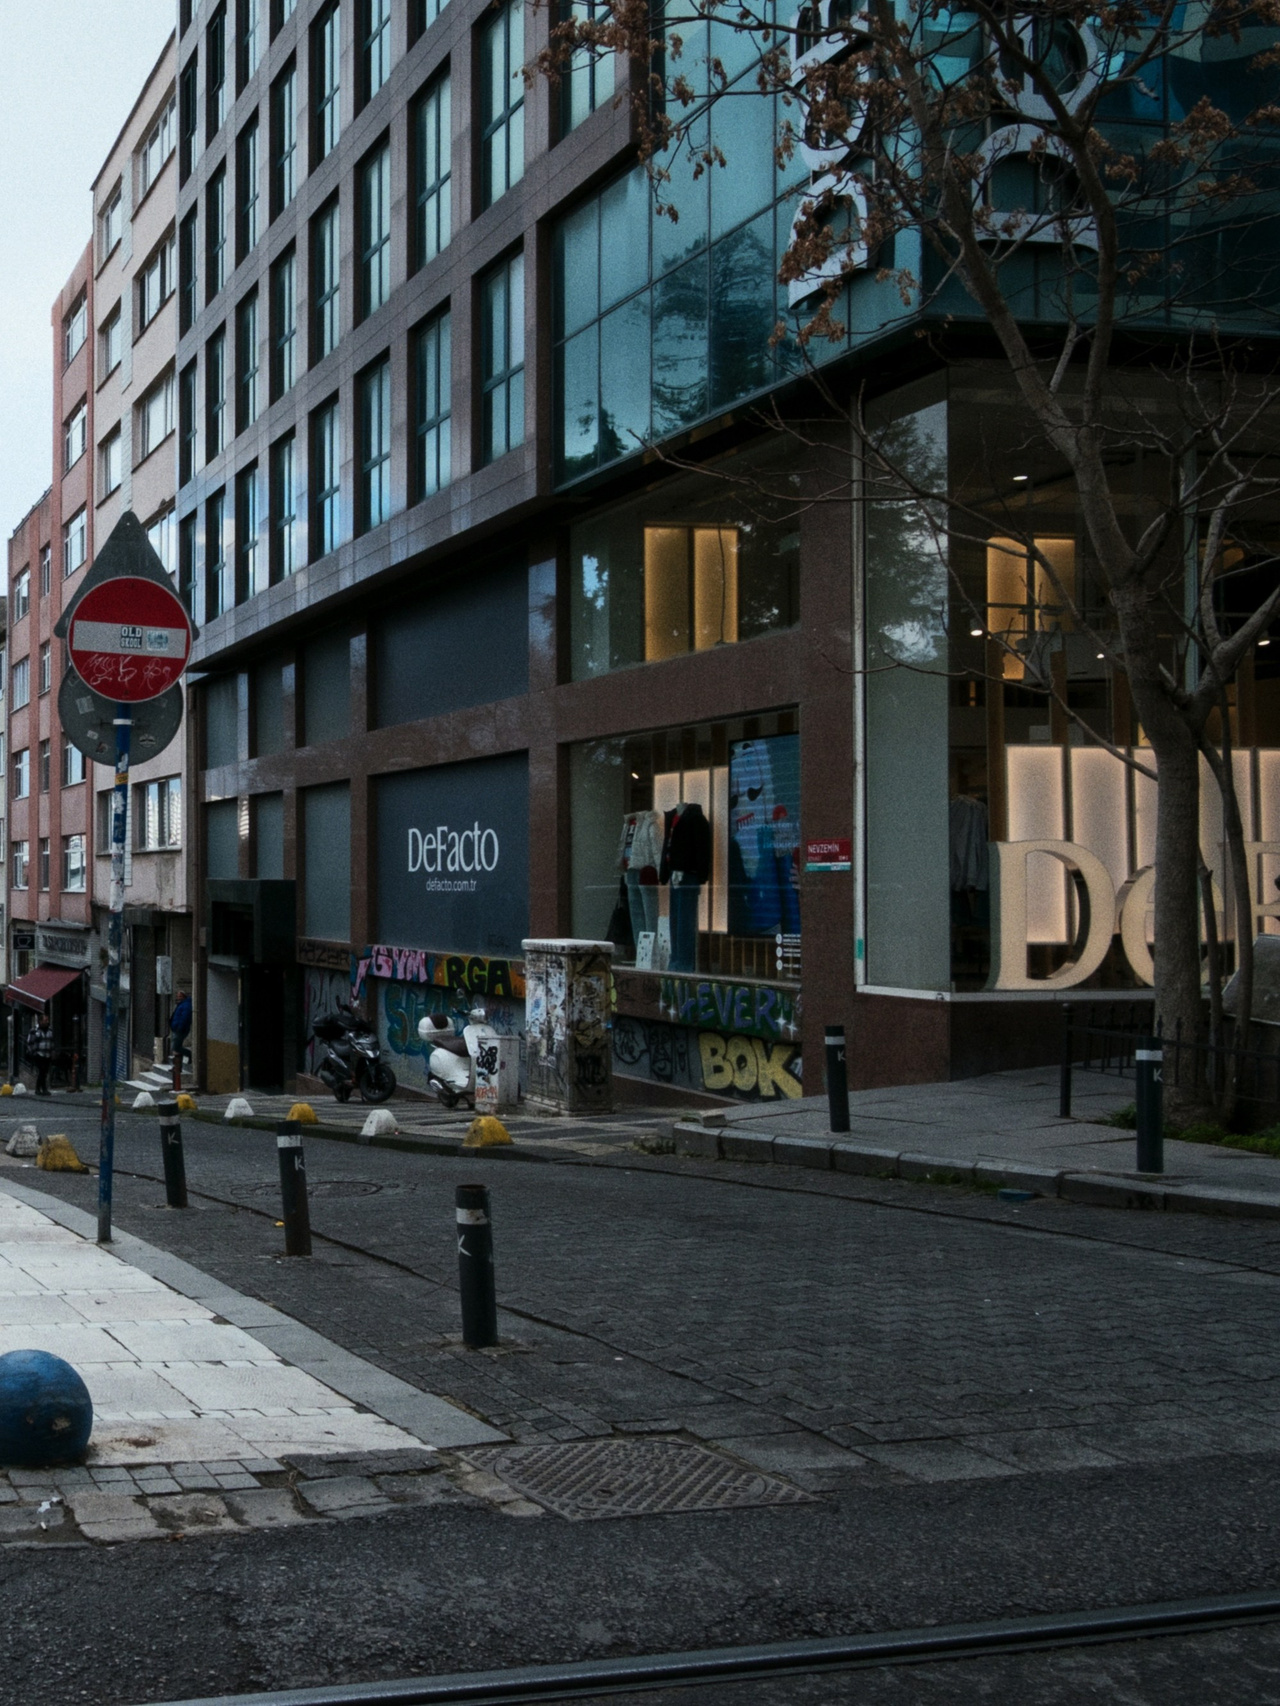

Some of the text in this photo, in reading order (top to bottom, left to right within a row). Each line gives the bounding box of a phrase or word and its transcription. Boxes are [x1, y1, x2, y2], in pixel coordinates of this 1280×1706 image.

[121, 626, 142, 638] OLD
[407, 821, 499, 872] DeFacto
[426, 877, 477, 891] defacto.com.tr
[445, 954, 513, 997] RGA
[698, 1031, 803, 1099] BOK
